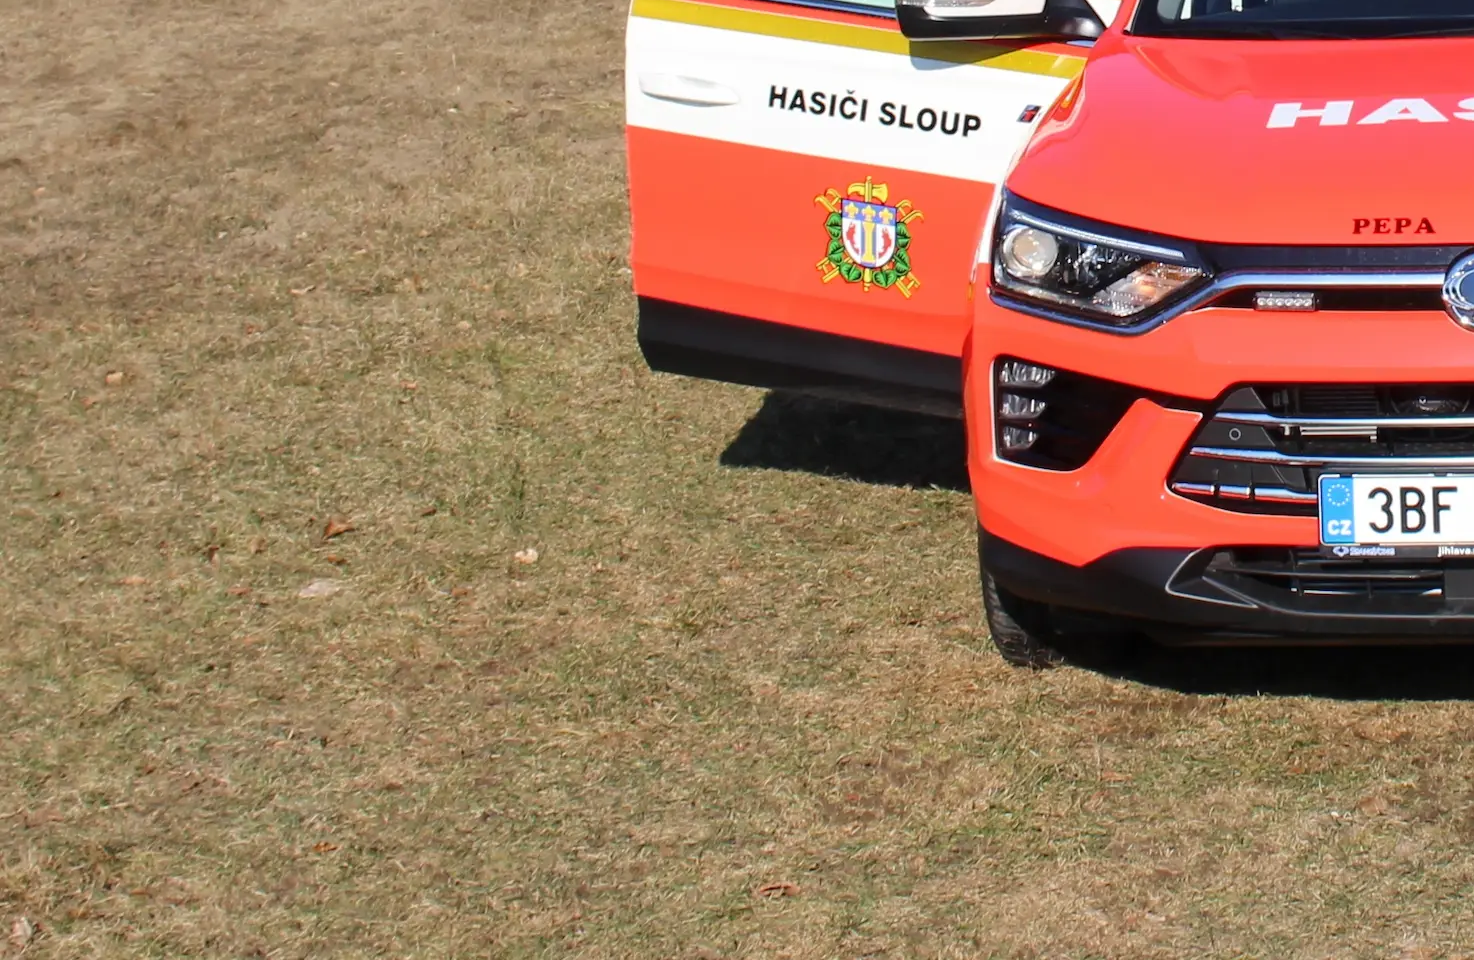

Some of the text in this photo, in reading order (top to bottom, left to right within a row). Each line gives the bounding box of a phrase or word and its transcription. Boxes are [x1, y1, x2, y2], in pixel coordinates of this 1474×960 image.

[768, 85, 869, 122] HASIČI
[879, 102, 982, 137] SLOUP
[1352, 217, 1436, 235] PEPA
[1367, 486, 1458, 534] 3BF
[1327, 521, 1352, 536] CZ
